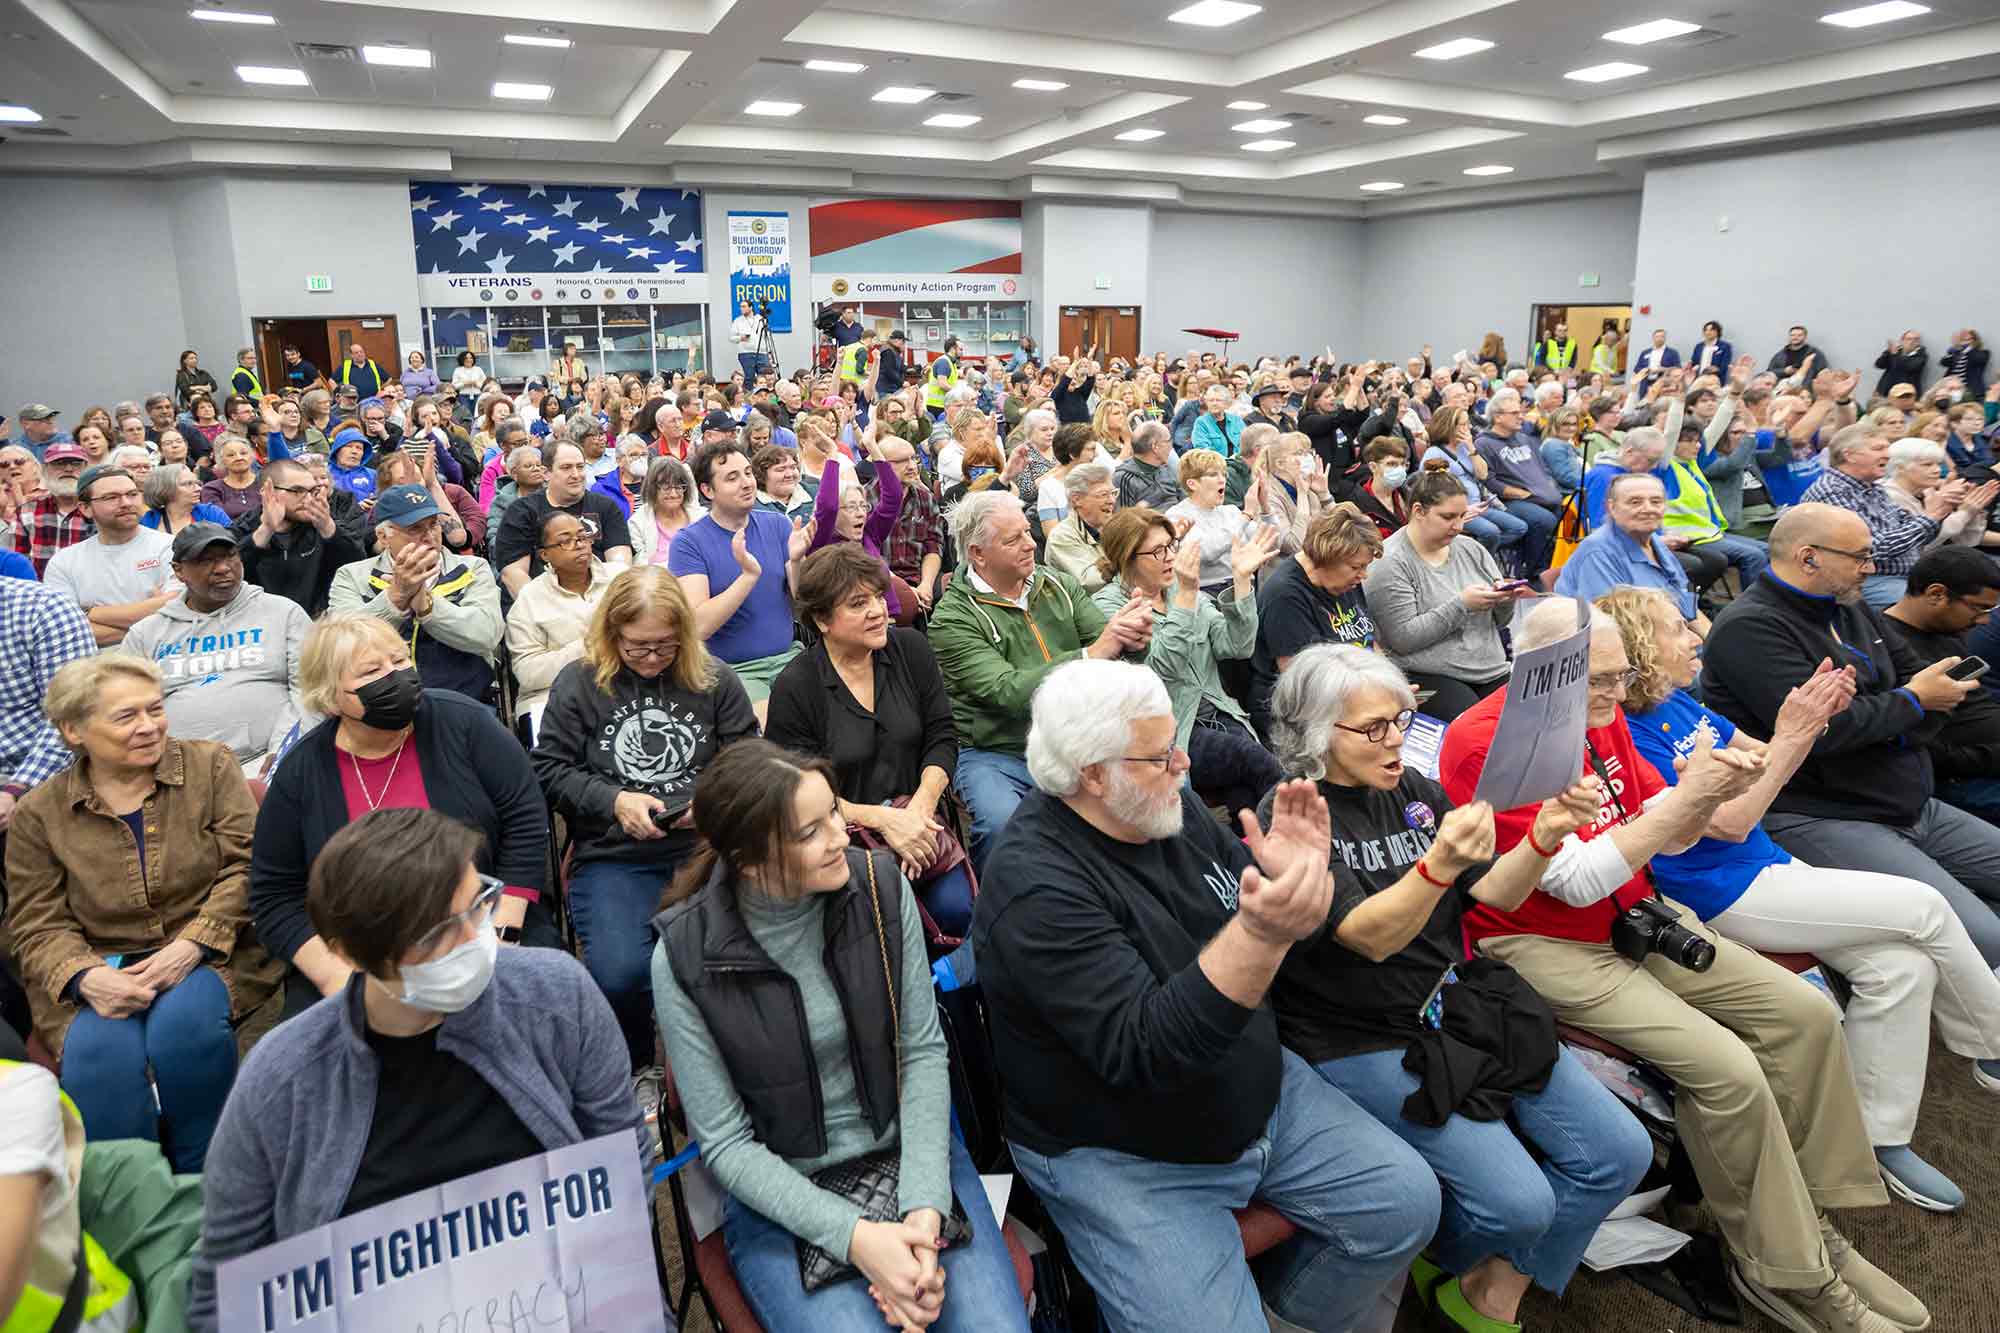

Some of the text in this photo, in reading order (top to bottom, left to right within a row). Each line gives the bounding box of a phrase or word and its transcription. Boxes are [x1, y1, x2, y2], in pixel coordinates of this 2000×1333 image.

[732, 236, 786, 244] BUILDING OUR
[736, 246, 783, 254] TOMORROW
[749, 256, 771, 264] TODAY
[448, 277, 532, 288] VETERANS
[857, 281, 996, 293] Community Action Program
[736, 284, 787, 303] REGION
[1522, 663, 1555, 701] I'M
[684, 711, 706, 744] BAY
[1361, 839, 1387, 872] OF
[260, 1166, 613, 1333] I'M FIGHTING FOR
